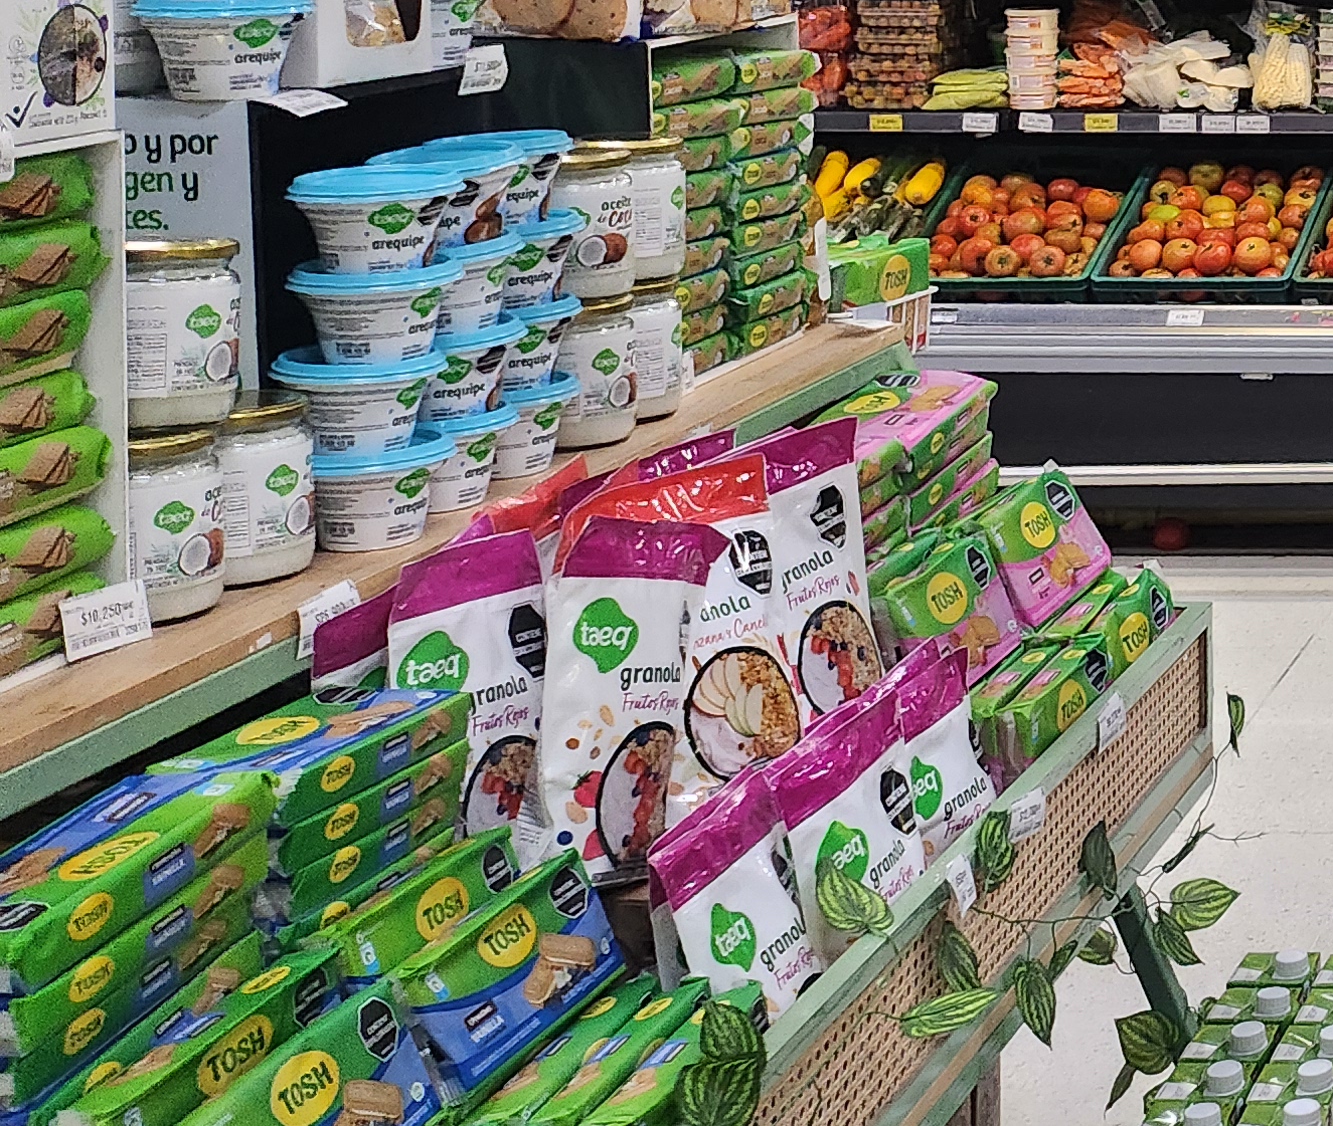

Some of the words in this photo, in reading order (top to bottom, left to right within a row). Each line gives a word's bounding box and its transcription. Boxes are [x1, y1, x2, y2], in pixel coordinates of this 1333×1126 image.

[144, 134, 162, 164] y
[169, 133, 219, 163] por
[181, 171, 199, 202] y
[884, 265, 910, 291] TOSH
[1024, 511, 1053, 539] TOSH
[700, 594, 752, 623] anola
[931, 581, 963, 613] TOSH
[580, 621, 634, 651] taeq
[1122, 622, 1149, 654] TOSH
[404, 652, 463, 687] taeq
[620, 662, 681, 692] granola
[621, 691, 658, 714] Frutos
[1060, 689, 1084, 722] TOSH
[943, 775, 988, 823] granola
[830, 834, 866, 870] aeq
[868, 839, 906, 888] granola
[422, 889, 465, 931] TOSH
[483, 911, 533, 956] TOSH
[714, 917, 750, 958] taeq
[207, 1025, 266, 1082] TOSH
[278, 1061, 335, 1115] TOSH
